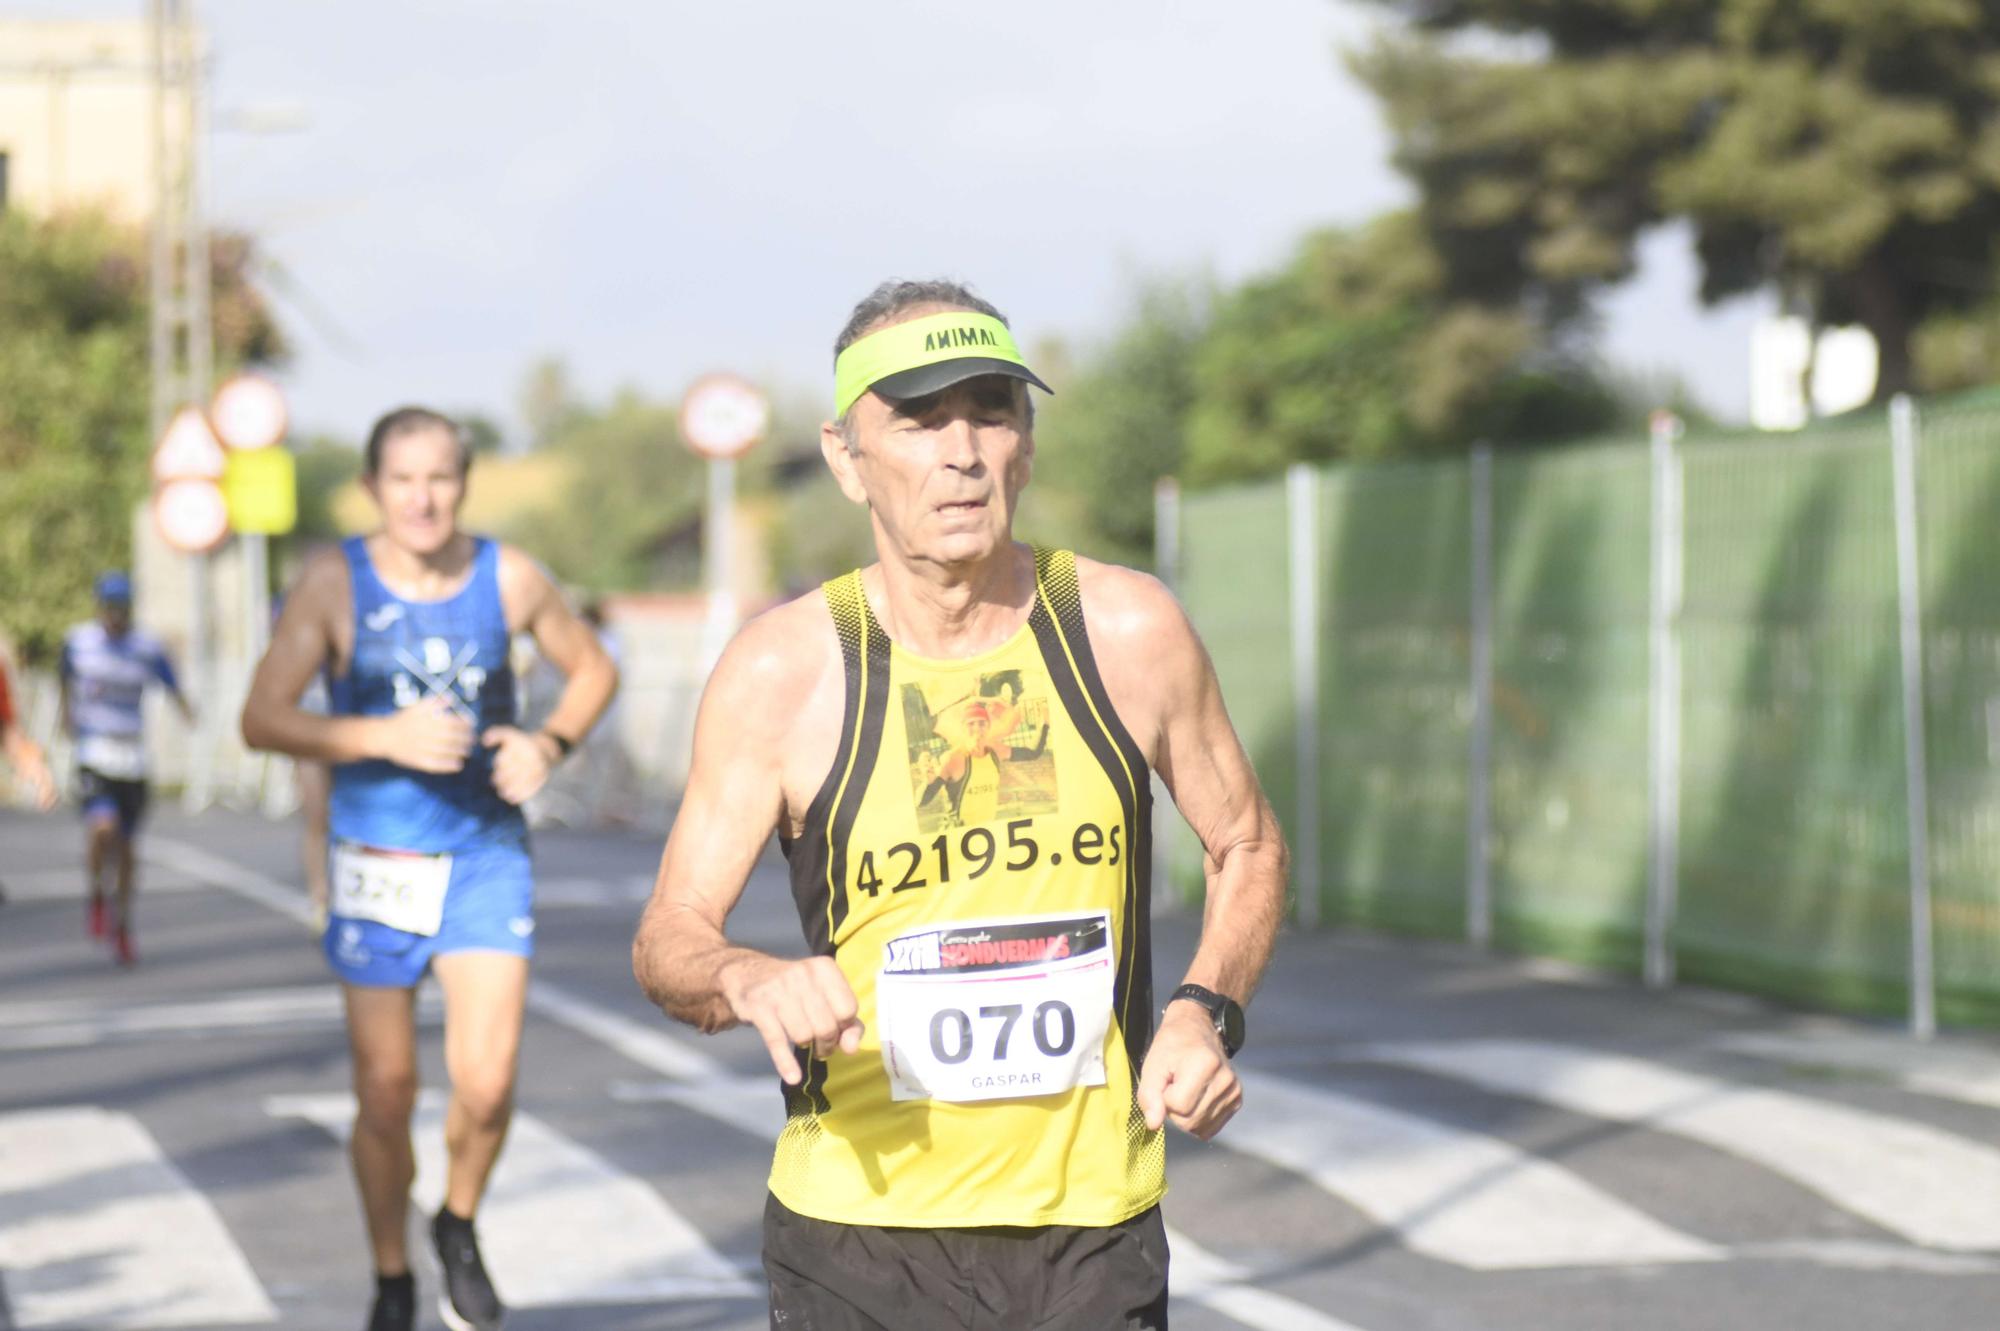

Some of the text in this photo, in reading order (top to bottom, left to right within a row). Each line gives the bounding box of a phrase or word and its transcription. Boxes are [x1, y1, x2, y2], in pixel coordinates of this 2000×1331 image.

[926, 328, 999, 351] ANIMAL
[856, 818, 1120, 897] 42195.es
[929, 1000, 1075, 1064] 070
[972, 1072, 1042, 1088] GASPAR
